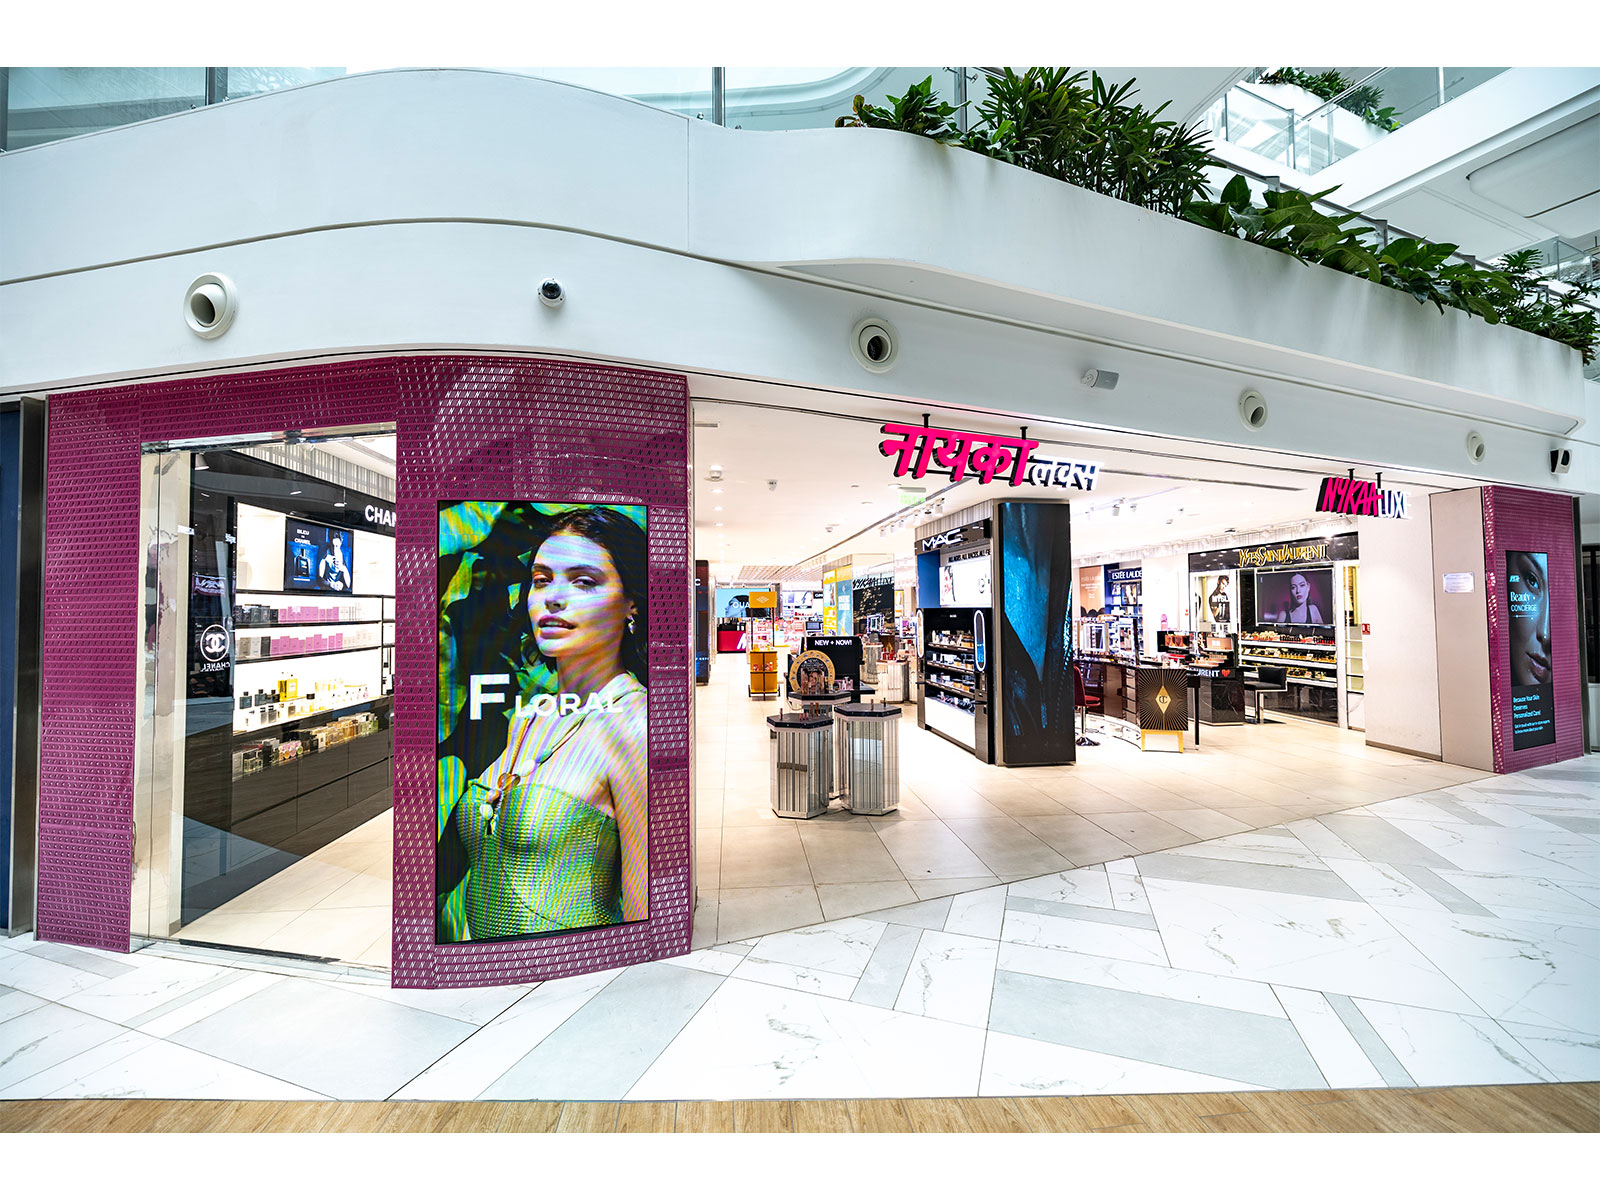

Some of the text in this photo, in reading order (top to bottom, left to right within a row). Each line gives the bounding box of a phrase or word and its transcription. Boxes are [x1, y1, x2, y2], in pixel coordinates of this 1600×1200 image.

[880, 423, 1040, 487] नायका
[1319, 477, 1381, 517] NYKAA
[1510, 591, 1530, 604] Beauty
[469, 673, 624, 721] FLORAL
